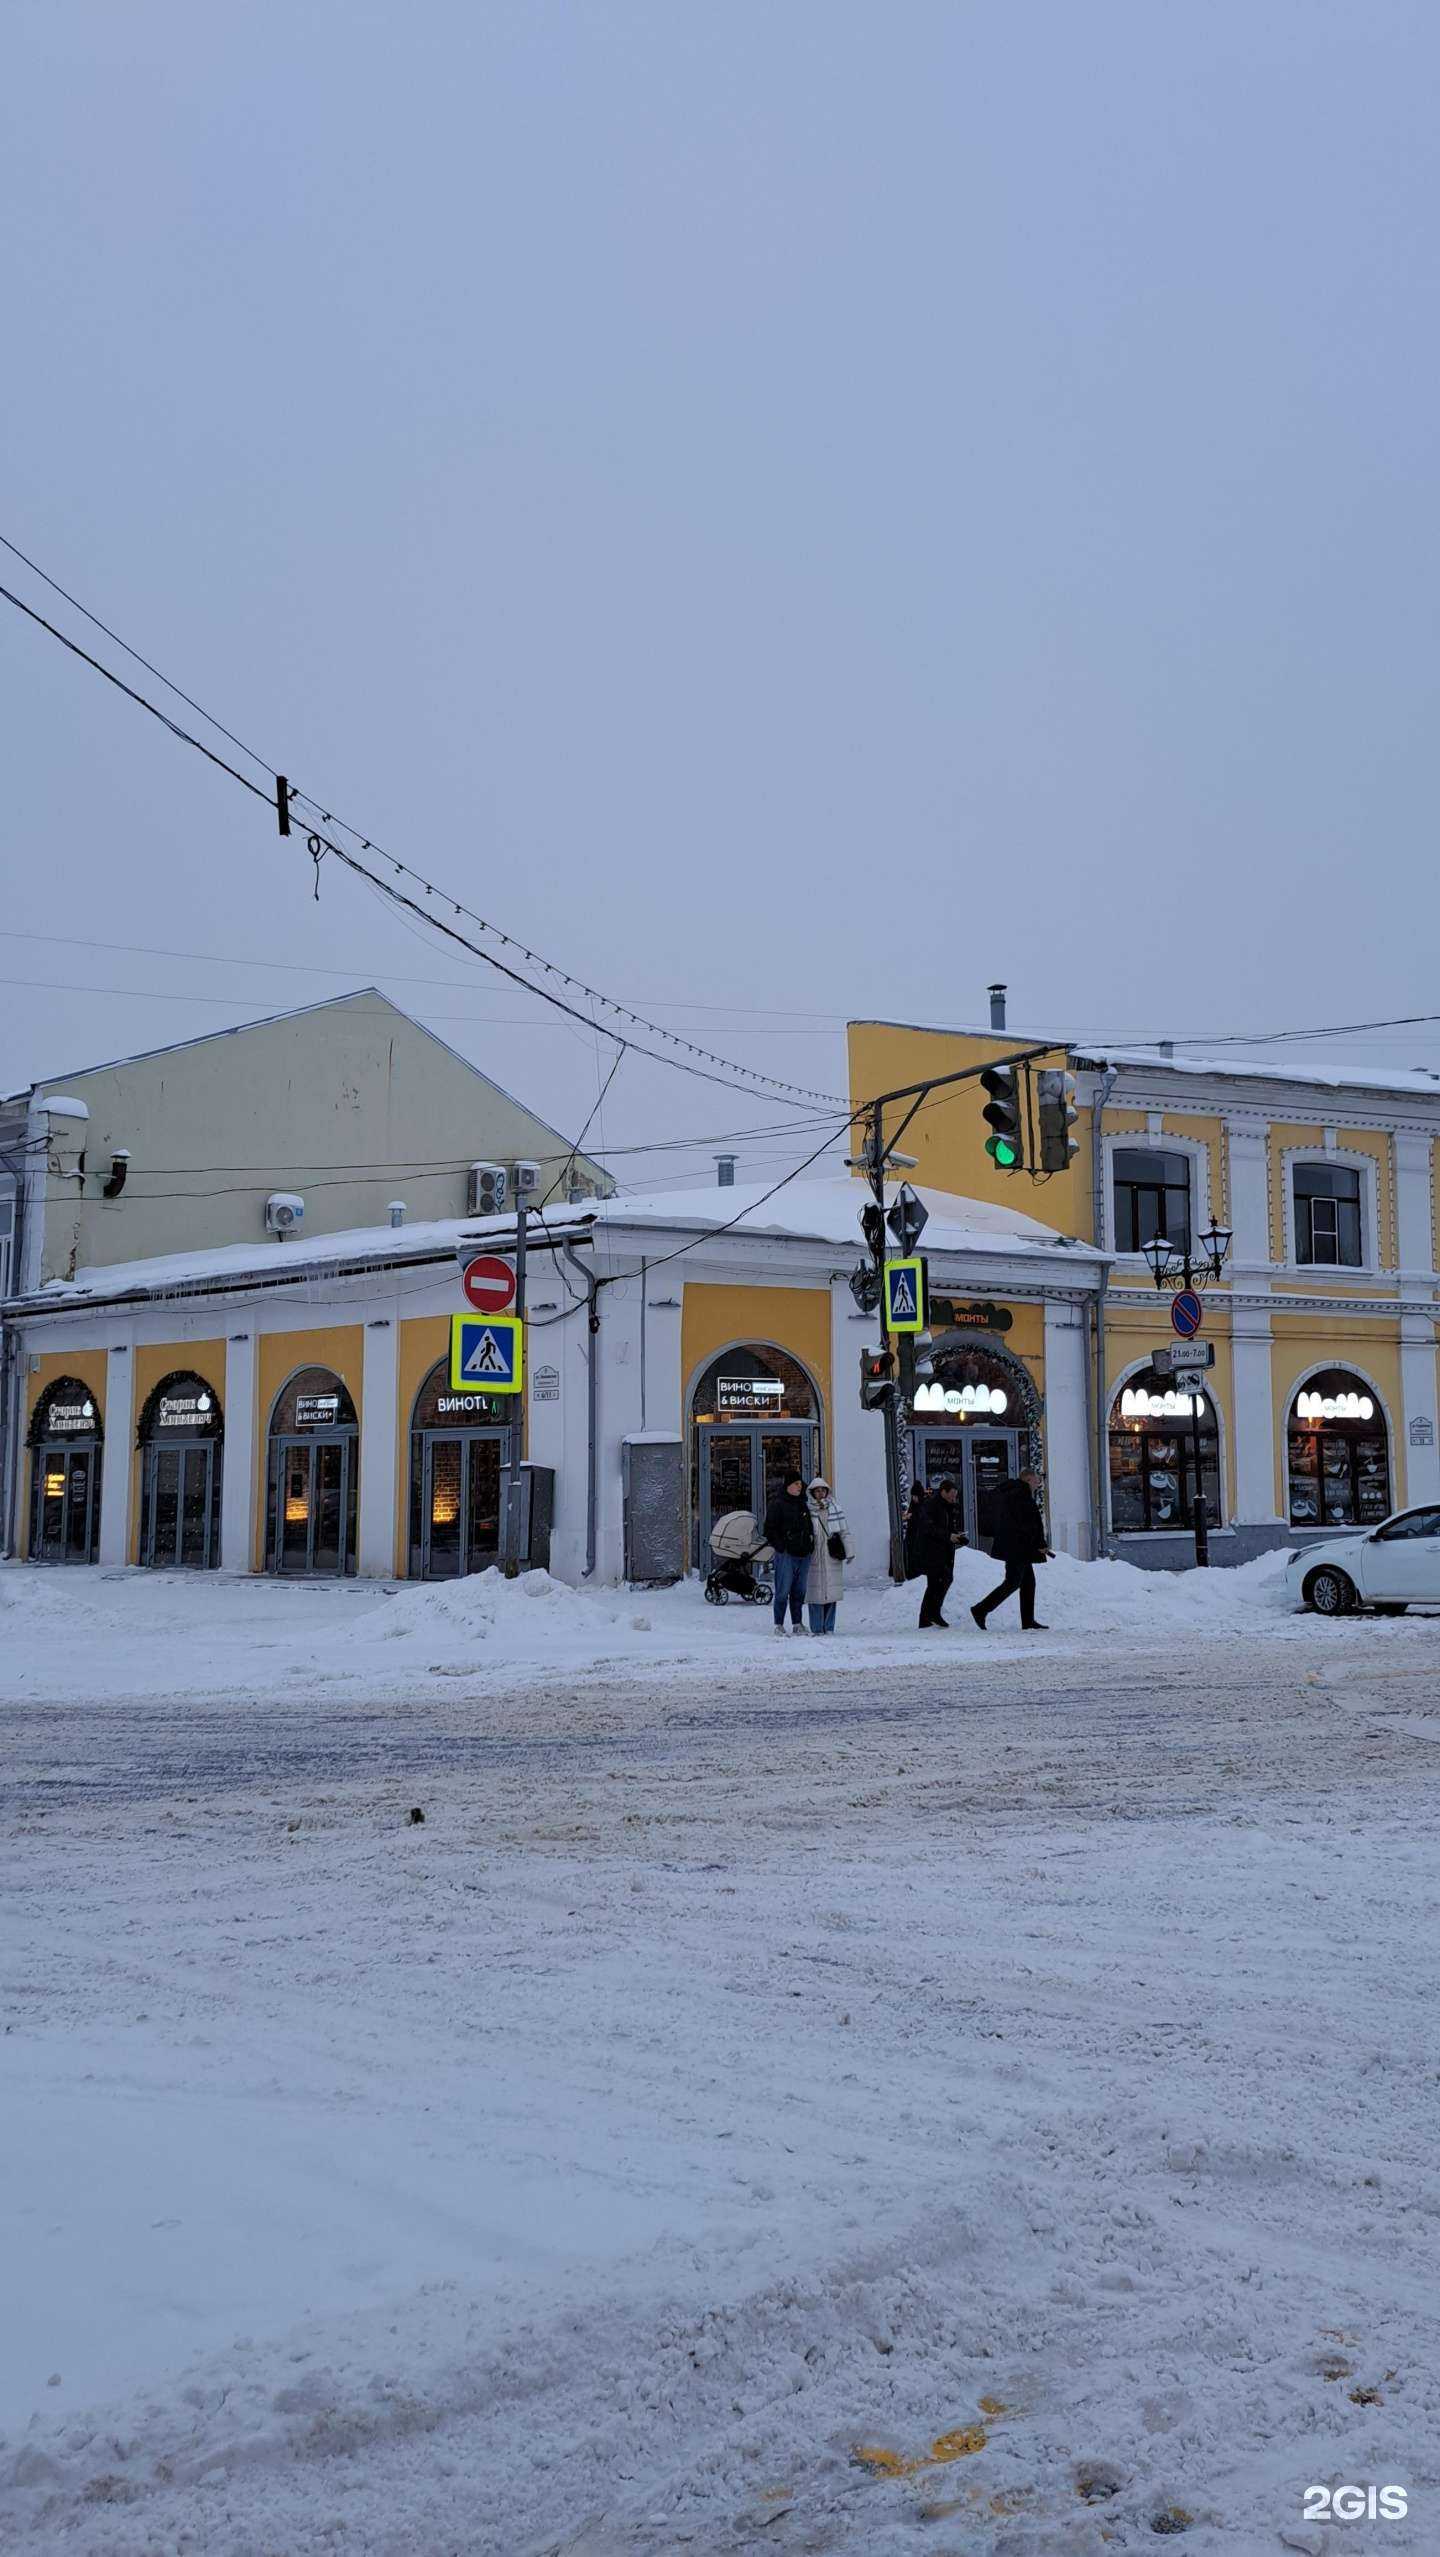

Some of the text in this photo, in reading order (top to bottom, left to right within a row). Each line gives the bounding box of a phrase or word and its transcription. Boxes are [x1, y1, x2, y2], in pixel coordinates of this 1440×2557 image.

[720, 1382, 752, 1392] ВИНО
[298, 1400, 317, 1408] ВИНО
[729, 1396, 770, 1406] ВИСКИ
[303, 1410, 329, 1420] ВИСКИ
